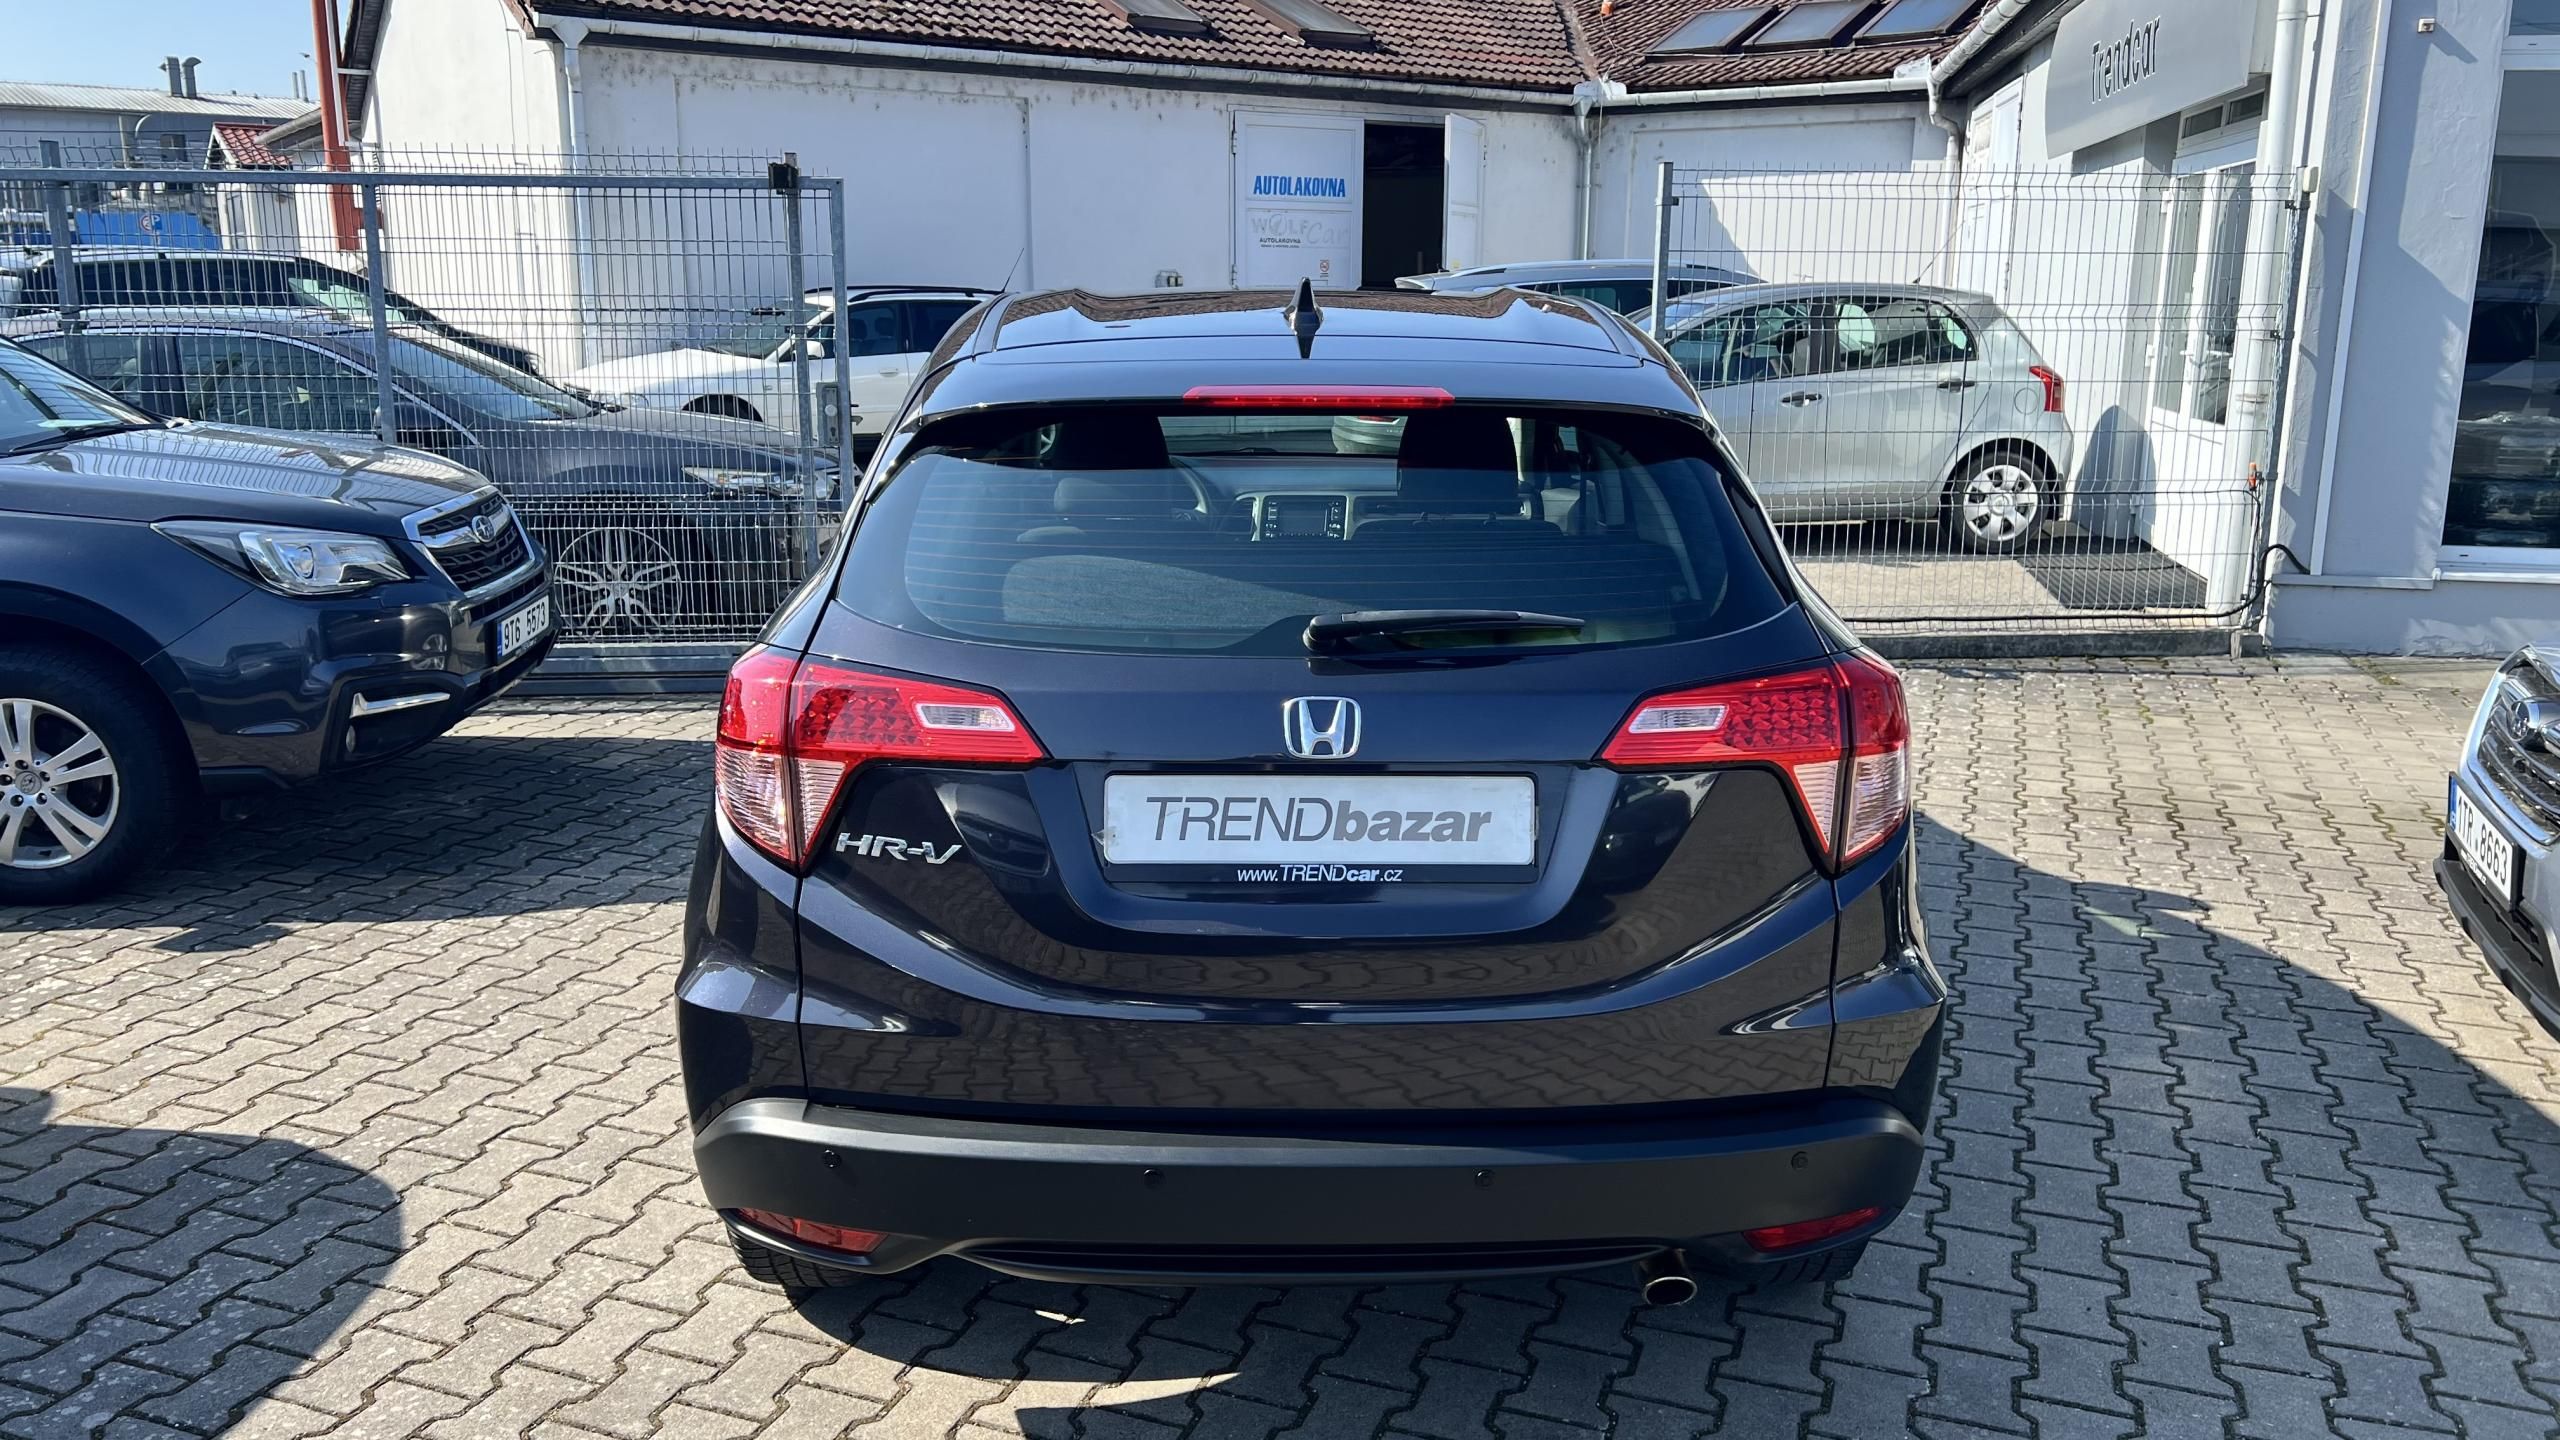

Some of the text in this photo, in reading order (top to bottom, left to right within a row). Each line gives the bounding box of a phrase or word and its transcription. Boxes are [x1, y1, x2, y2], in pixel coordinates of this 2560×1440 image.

[2092, 16, 2161, 104] Trendcar
[1253, 175, 1346, 197] AUTOLAKOVNA
[504, 617, 520, 649] 9T6
[526, 602, 545, 635] 5573
[1146, 796, 1492, 842] TRENDbazar
[2458, 796, 2474, 848] 1TR
[2480, 823, 2508, 886] 8663
[835, 832, 963, 865] HR-V
[1237, 864, 1403, 882] www.TRENDcar.cz
